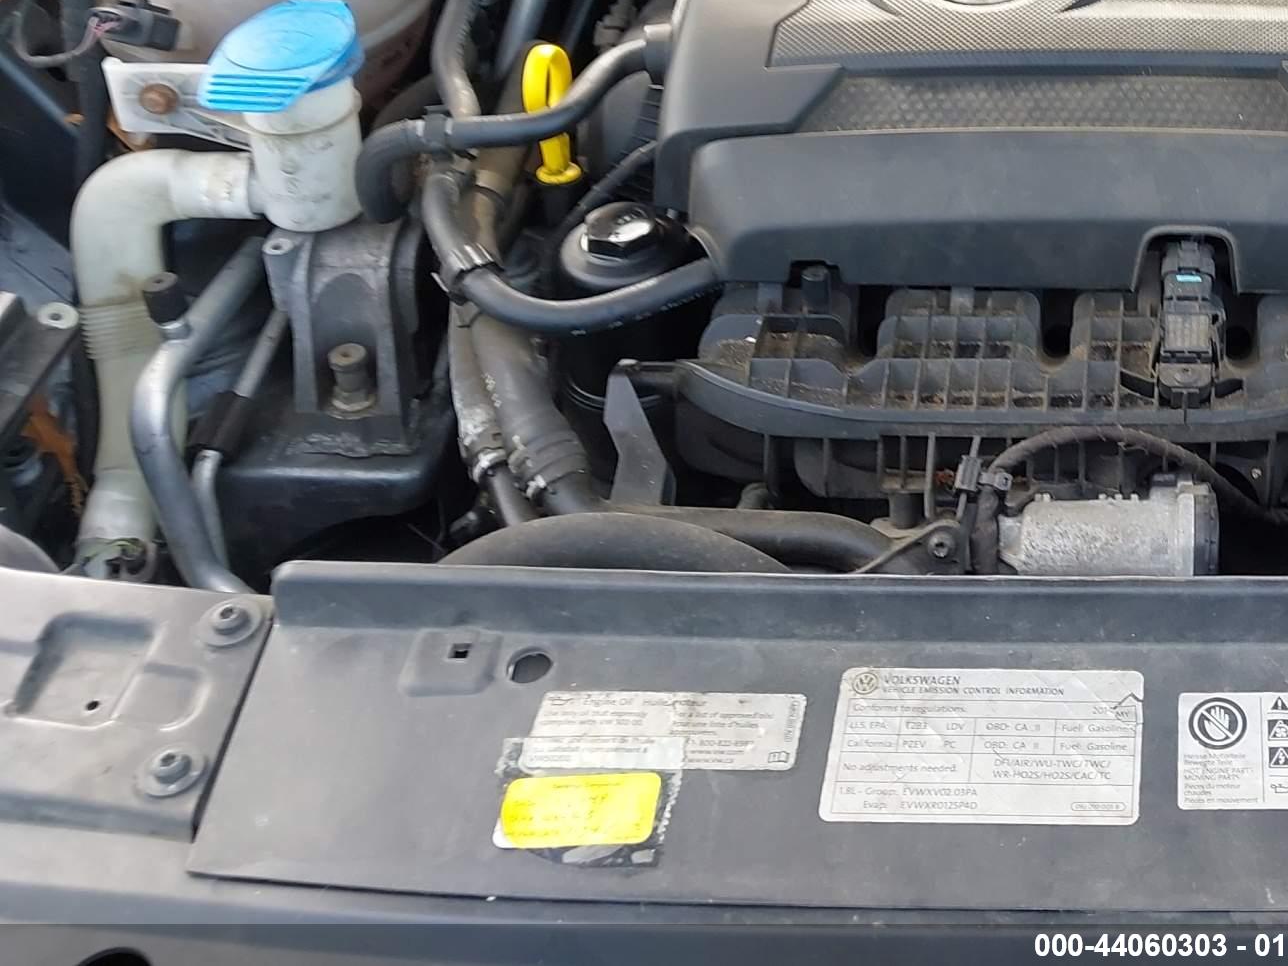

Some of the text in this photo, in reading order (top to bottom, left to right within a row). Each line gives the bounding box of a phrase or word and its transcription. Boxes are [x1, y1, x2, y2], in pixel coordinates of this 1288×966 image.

[885, 675, 960, 685] VOLKSWAGEN
[883, 686, 1064, 696] VEHICLE EMISSION CONTROL INFORMATION
[1087, 742, 1128, 751] Gasoline
